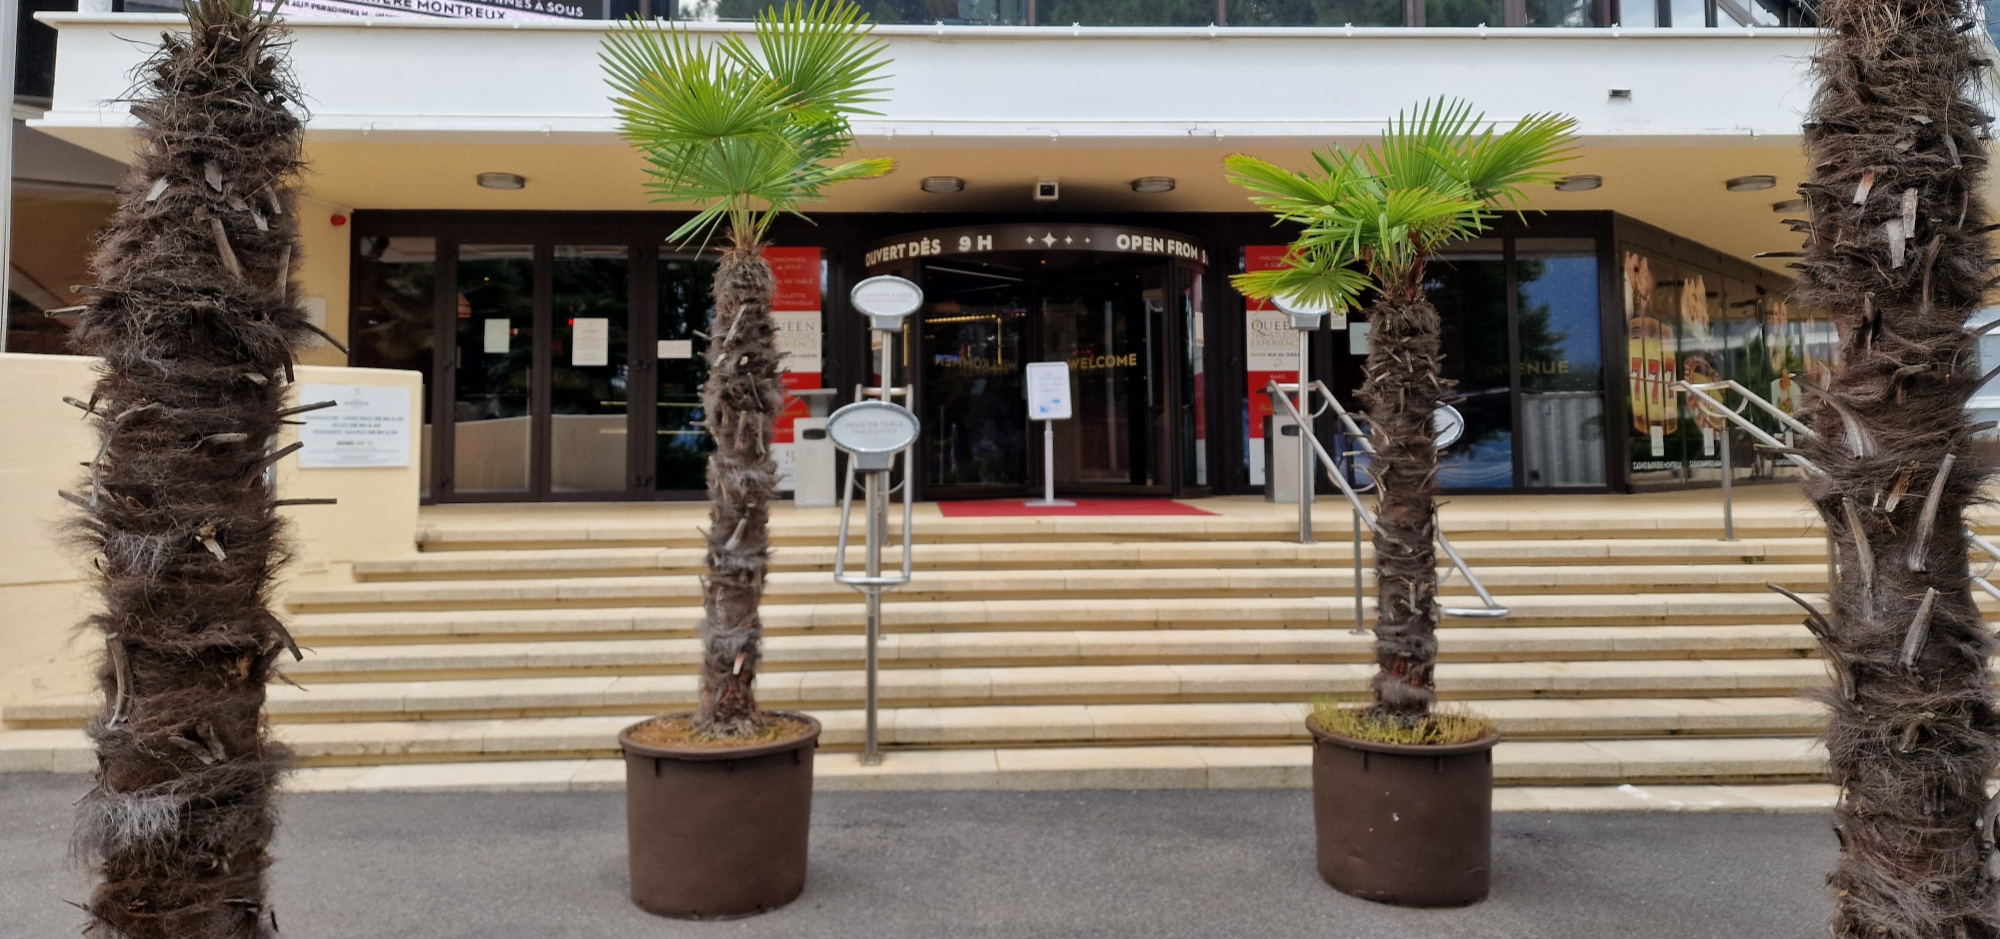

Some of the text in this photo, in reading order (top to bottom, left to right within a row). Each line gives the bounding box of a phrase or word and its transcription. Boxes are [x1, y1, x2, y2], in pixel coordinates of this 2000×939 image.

[417, 0, 506, 19] MONTREUX
[546, 2, 584, 17] SOUS
[865, 234, 993, 267] OUVERT DÈS 9 H
[1116, 234, 1165, 253] OPEN
[1167, 238, 1199, 260] FROM
[777, 321, 815, 331] UEEN
[1251, 319, 1291, 336] QUEE
[1067, 353, 1137, 370] WELCOME
